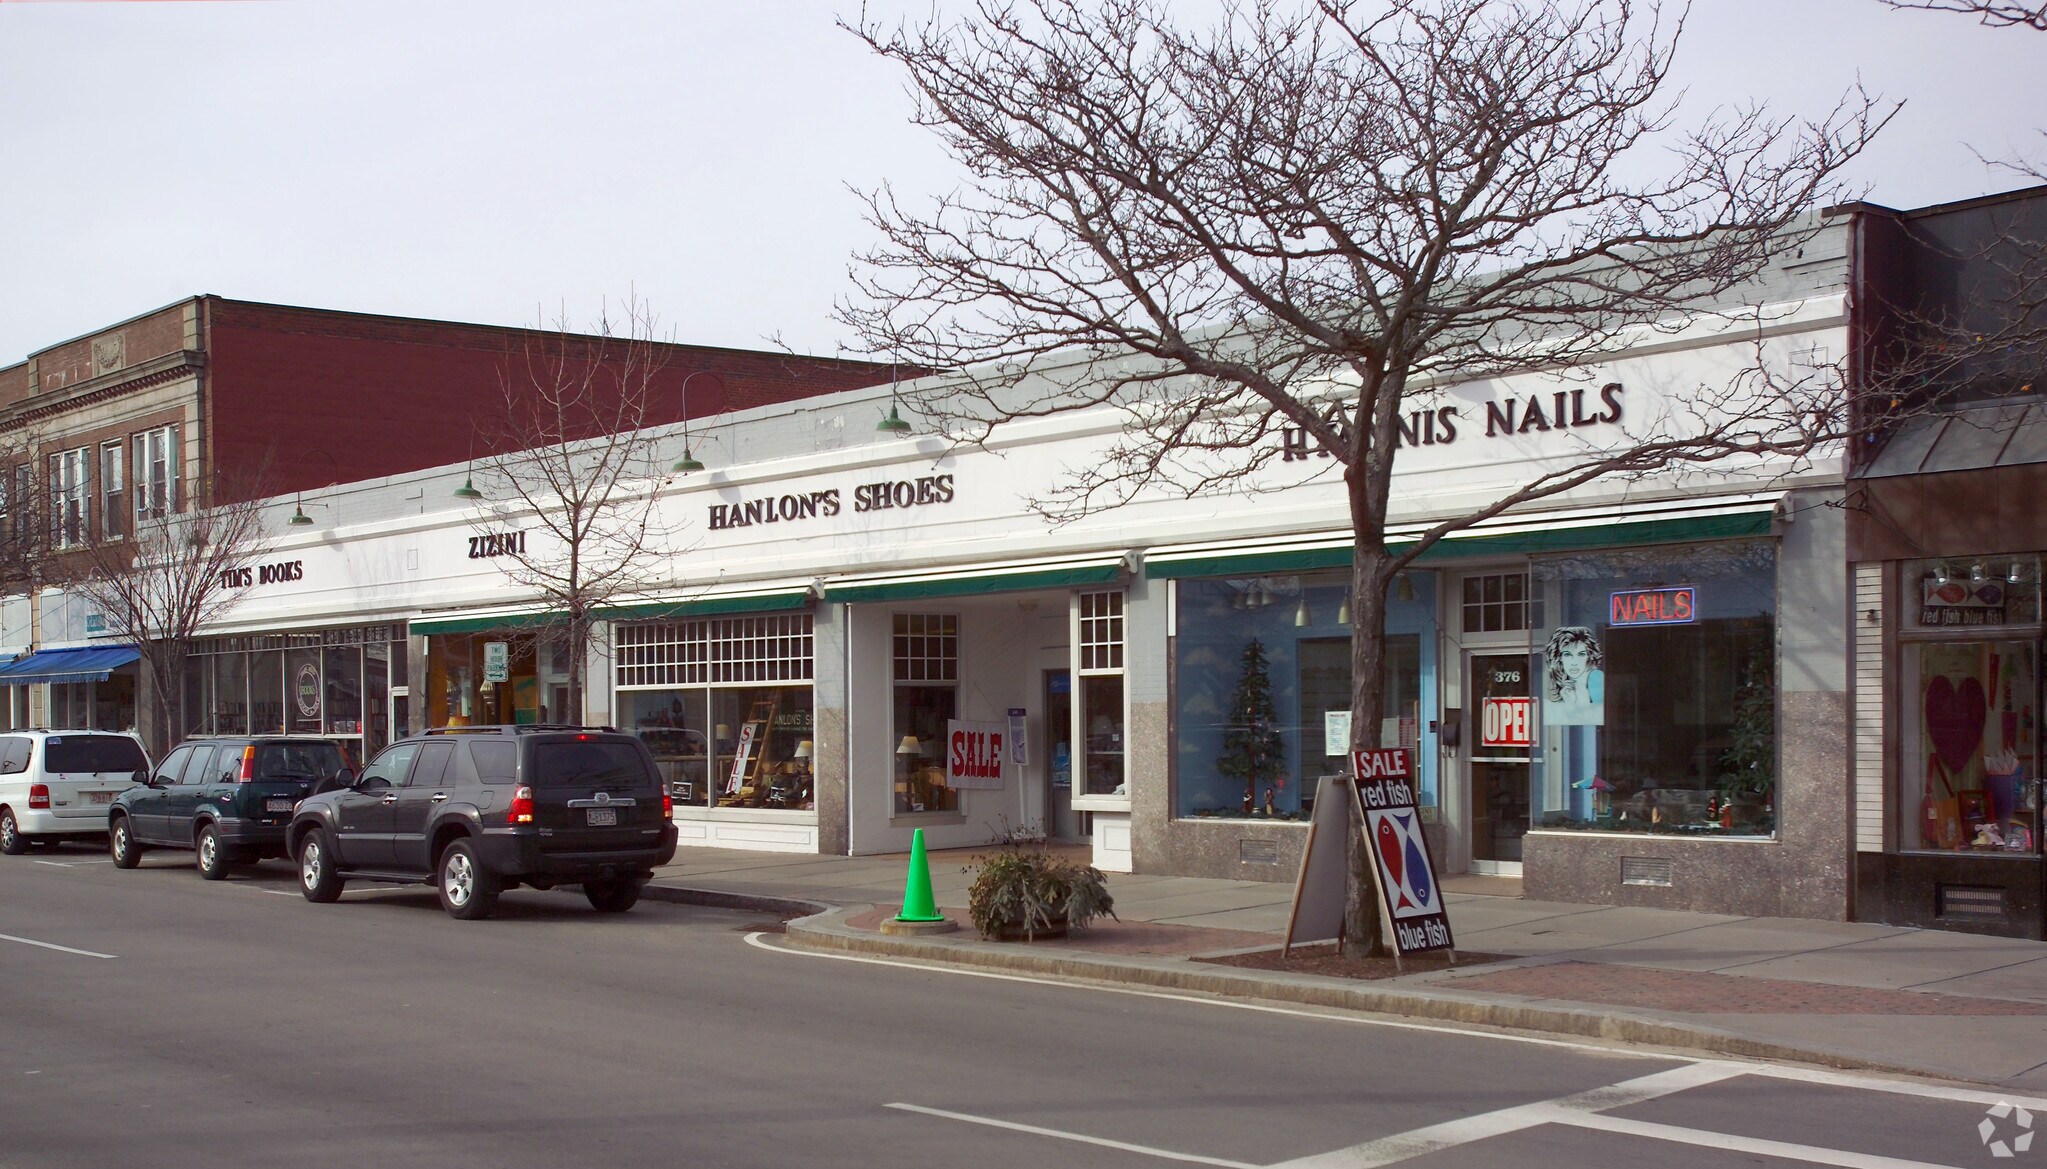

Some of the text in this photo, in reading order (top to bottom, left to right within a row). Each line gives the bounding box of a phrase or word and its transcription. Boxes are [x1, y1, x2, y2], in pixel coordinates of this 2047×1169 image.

[1282, 383, 1623, 461] HNIS NAILS
[708, 474, 954, 530] HANLON'S SHOES
[220, 560, 303, 589] TIM'S BOOKS
[1613, 591, 1691, 622] NAILS
[1921, 608, 1939, 623] red
[1963, 609, 1984, 624] blue
[1495, 670, 1520, 683] 376
[774, 714, 801, 725] ANLON'S
[1485, 702, 1537, 742] OPEN
[952, 730, 1002, 778] SALE
[1360, 750, 1407, 778] SALE
[1360, 779, 1414, 807] red fish
[1396, 918, 1450, 950] blue fish
